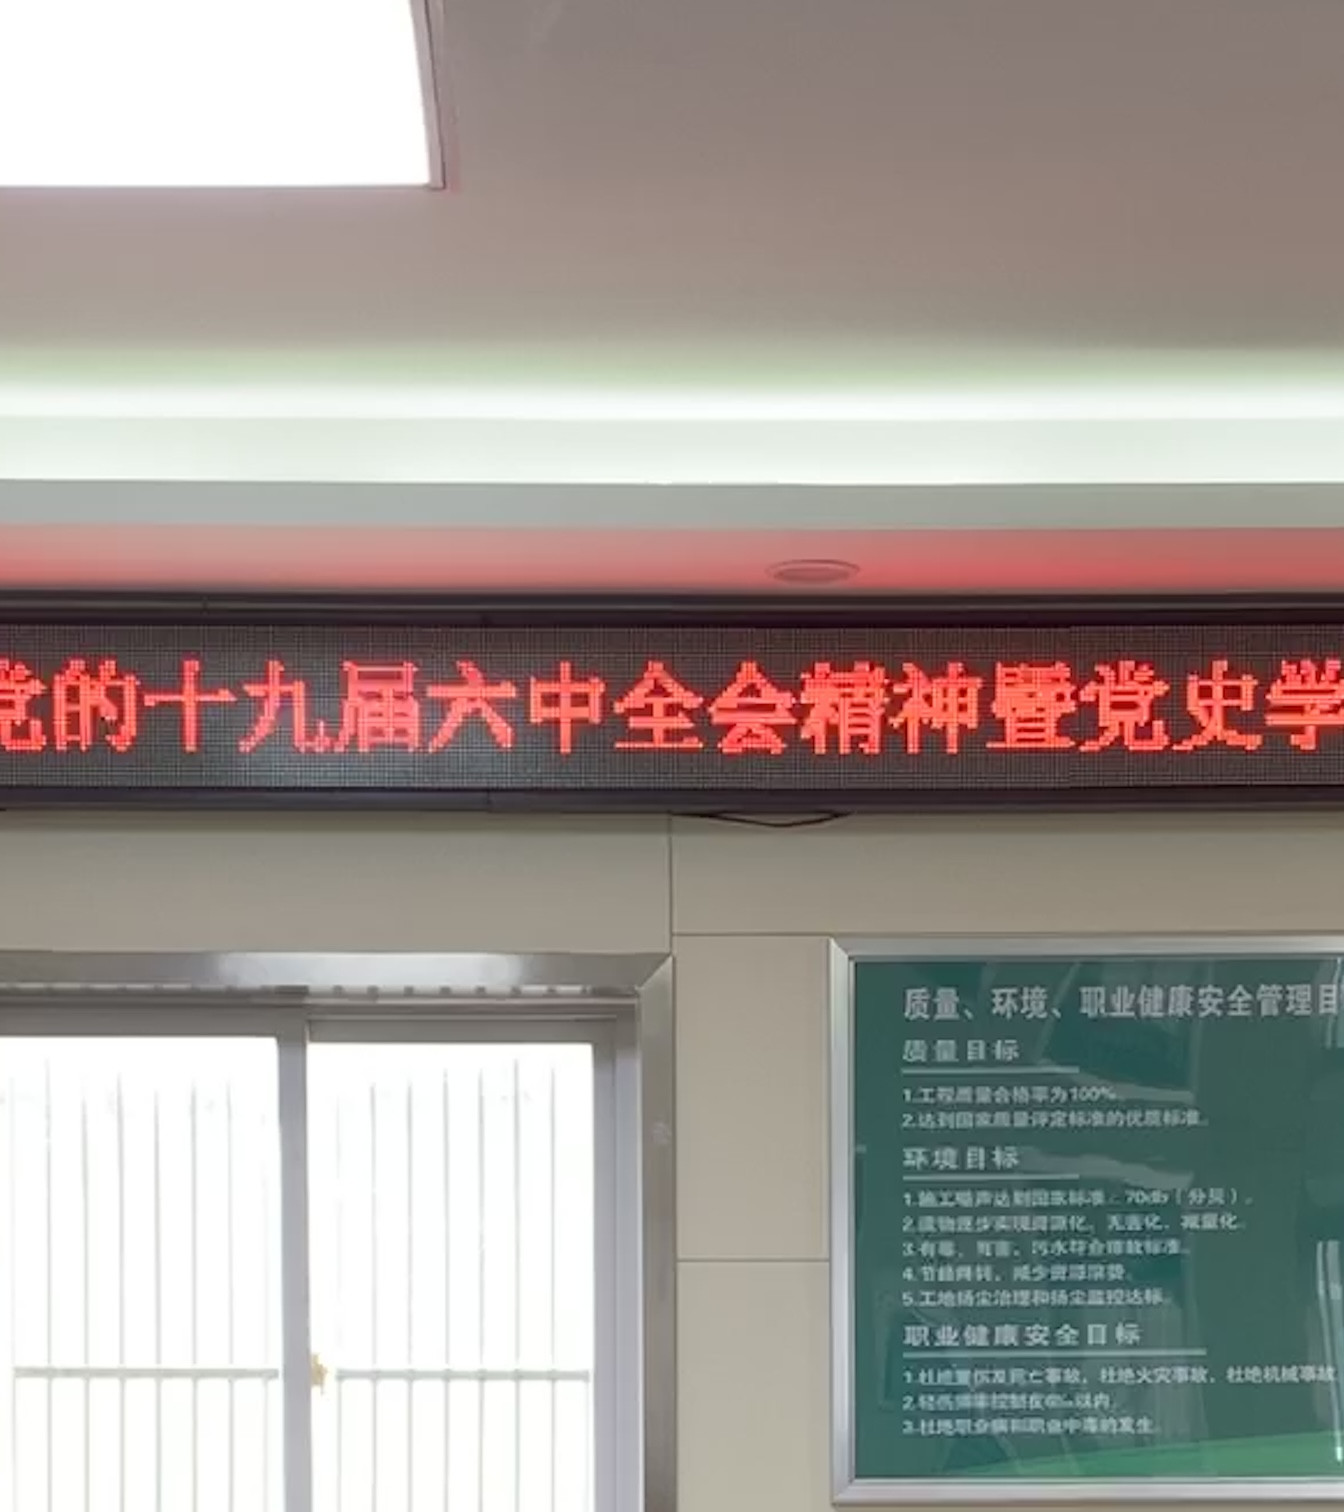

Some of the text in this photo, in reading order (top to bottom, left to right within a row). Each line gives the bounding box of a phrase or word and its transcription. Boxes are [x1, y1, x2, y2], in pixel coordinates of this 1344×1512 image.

[902, 1039, 1020, 1063] 质量目标
[903, 1146, 1020, 1171] 环境目标
[903, 1323, 1142, 1348] 职业健康安全目标
